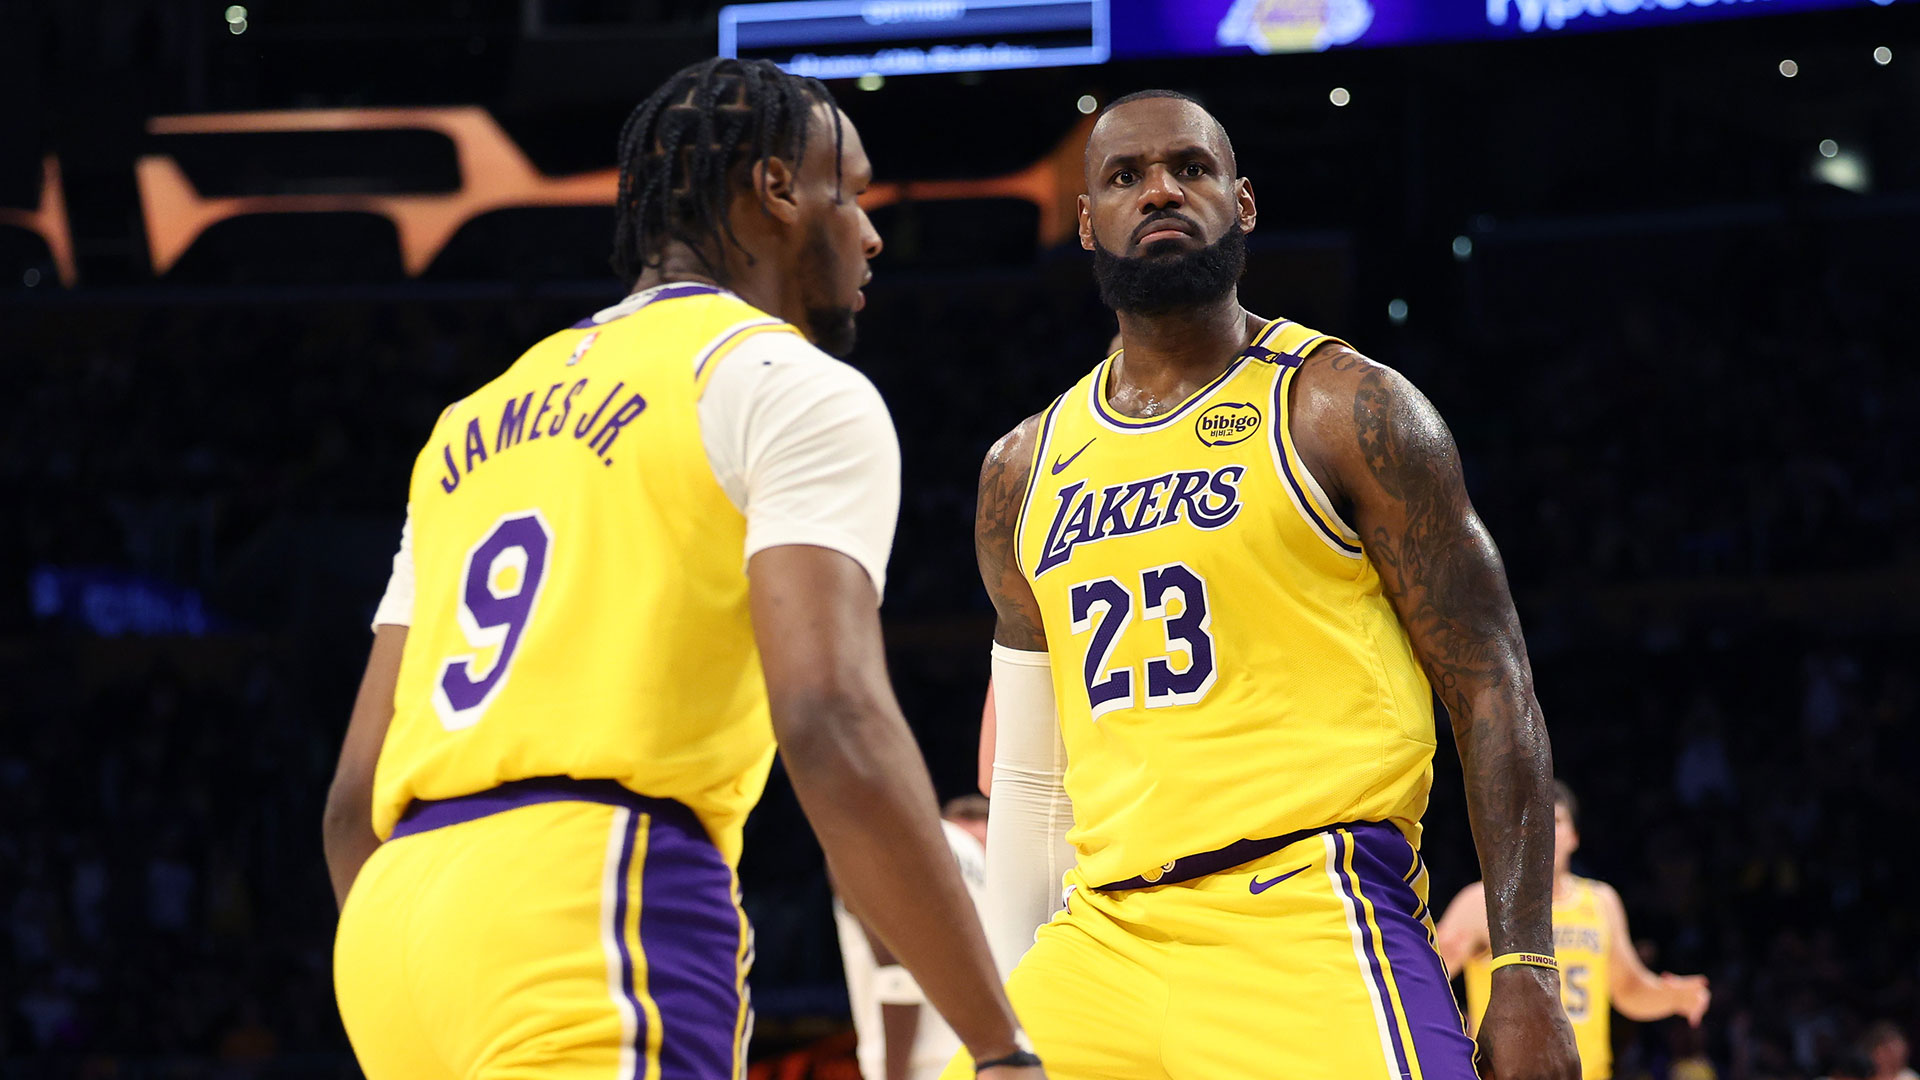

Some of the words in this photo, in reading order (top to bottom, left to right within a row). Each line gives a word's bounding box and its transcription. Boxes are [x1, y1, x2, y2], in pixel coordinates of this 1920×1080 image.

[440, 378, 588, 494] JAMES
[574, 382, 647, 467] JR.
[1202, 414, 1257, 432] bibigo
[1034, 465, 1248, 580] LAKERS
[431, 508, 553, 730] 9
[1068, 561, 1218, 722] 23
[1519, 954, 1557, 966] PROMISE
